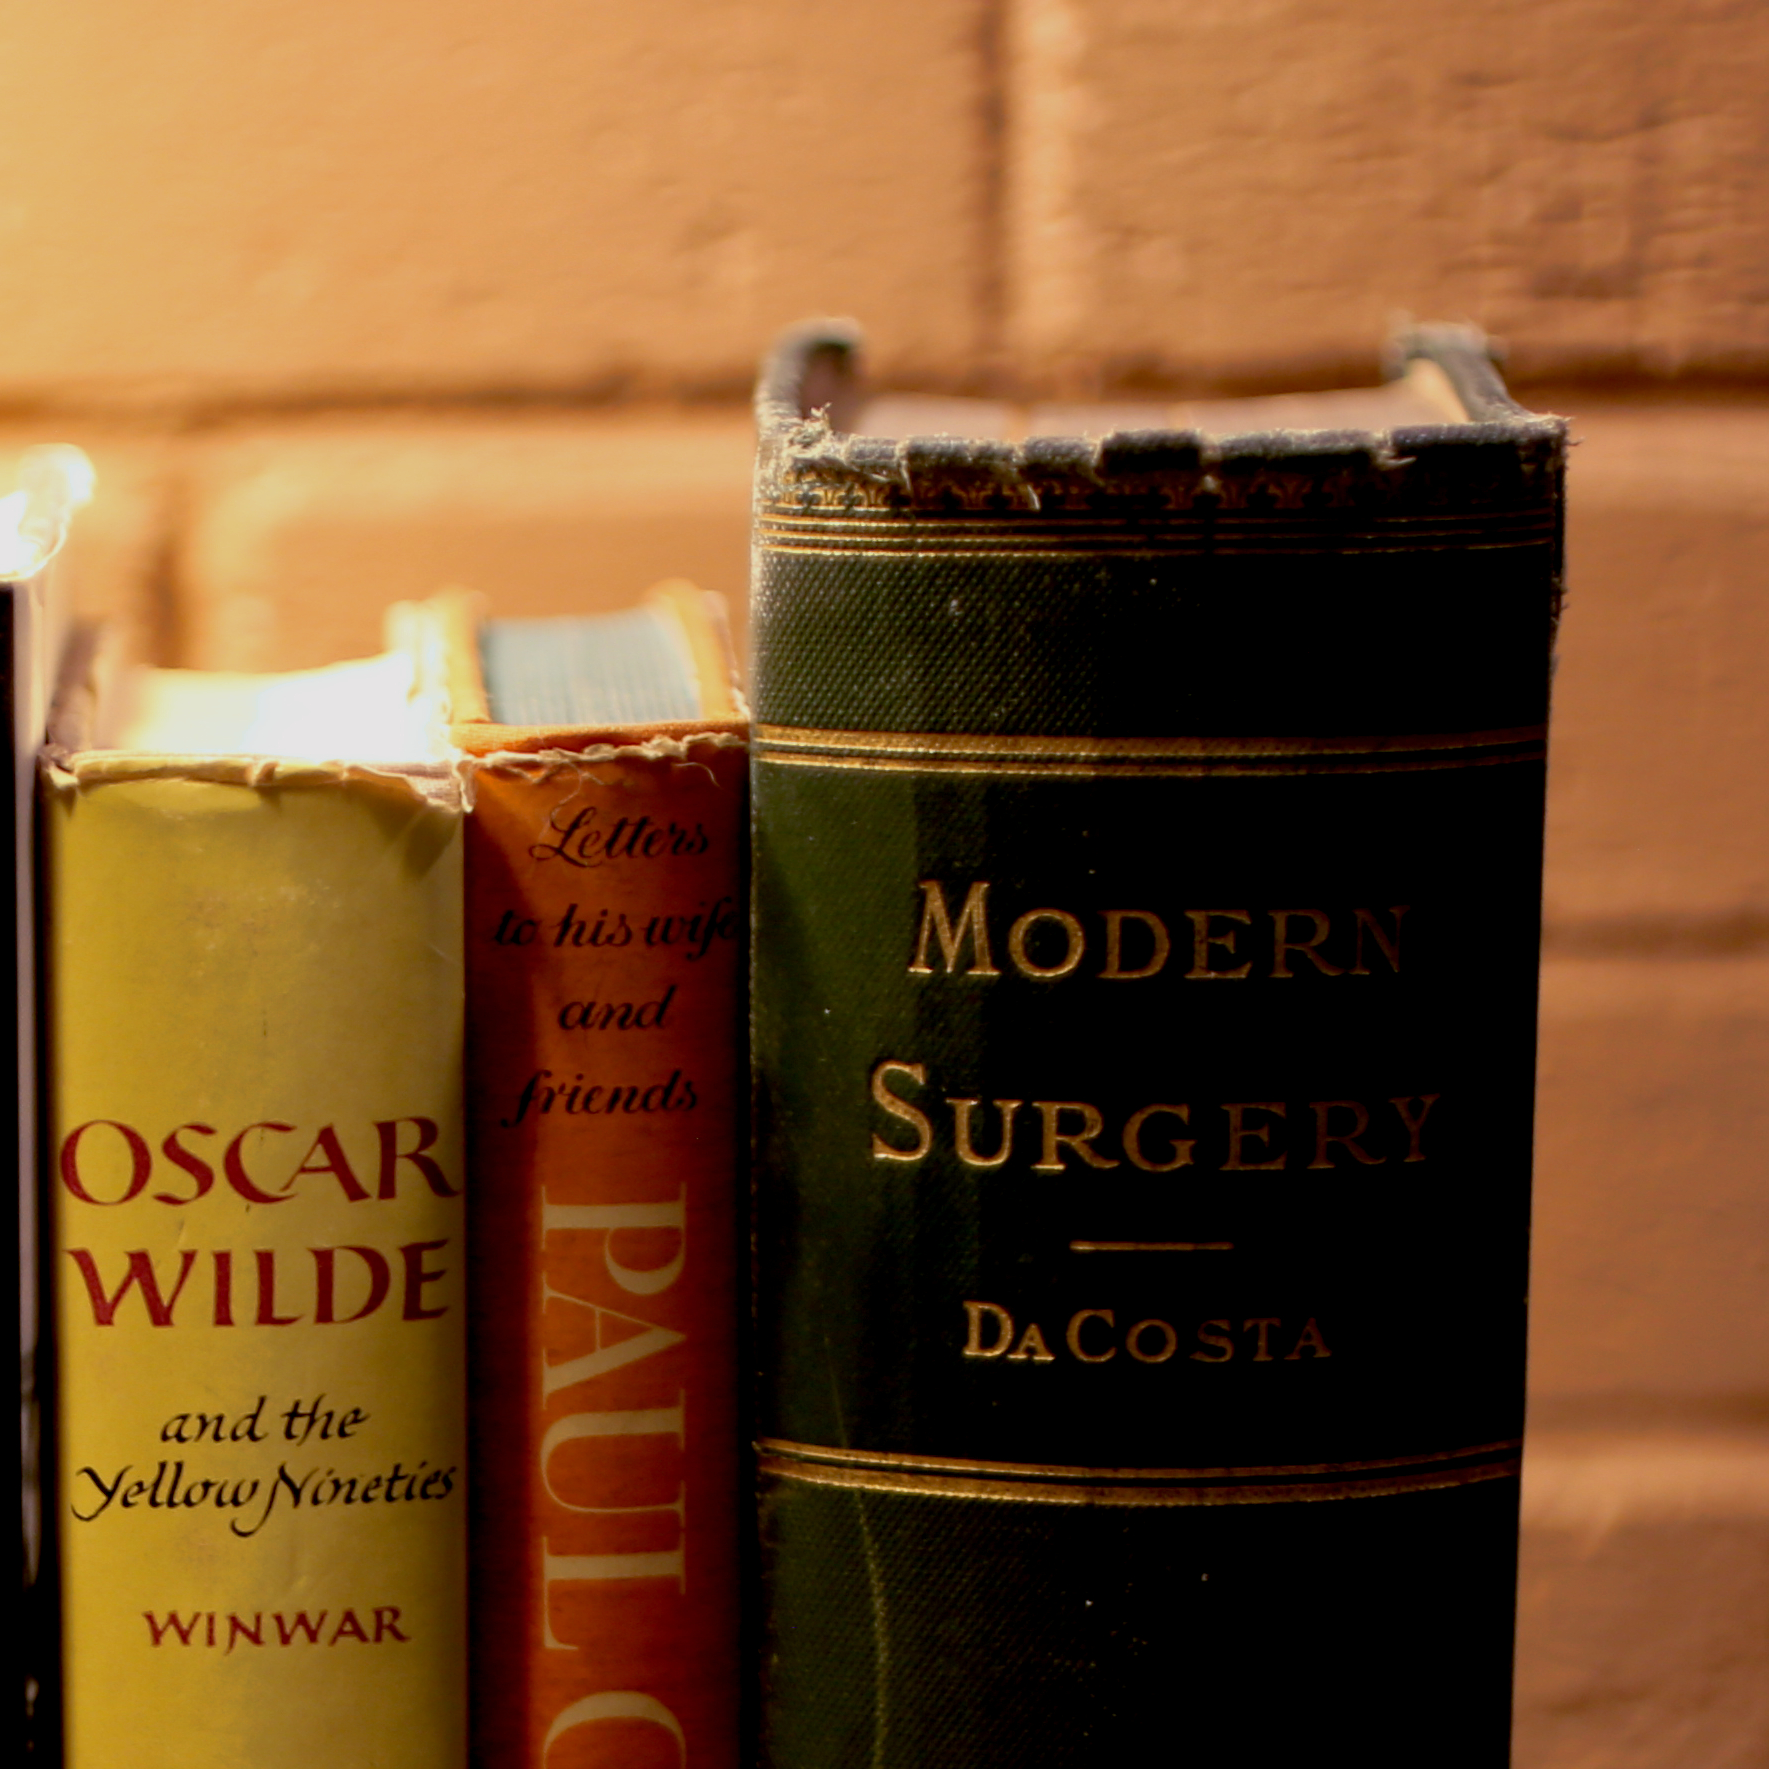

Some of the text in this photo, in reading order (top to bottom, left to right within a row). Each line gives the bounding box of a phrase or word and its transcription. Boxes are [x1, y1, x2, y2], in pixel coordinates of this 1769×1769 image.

[529, 806, 709, 868] Letters
[493, 910, 538, 947] to
[553, 903, 633, 948] his
[908, 878, 1411, 980] MODERN
[558, 984, 678, 1031] and
[500, 1068, 698, 1129] friends
[870, 1059, 1443, 1173] SURGERY
[60, 1116, 462, 1206] OSCAR
[64, 1238, 451, 1327] WILDE
[159, 1393, 370, 1446] and the
[539, 1181, 688, 1651] PAUL
[71, 1460, 459, 1537] Yellow Nineties
[142, 1606, 411, 1656] WINWAR
